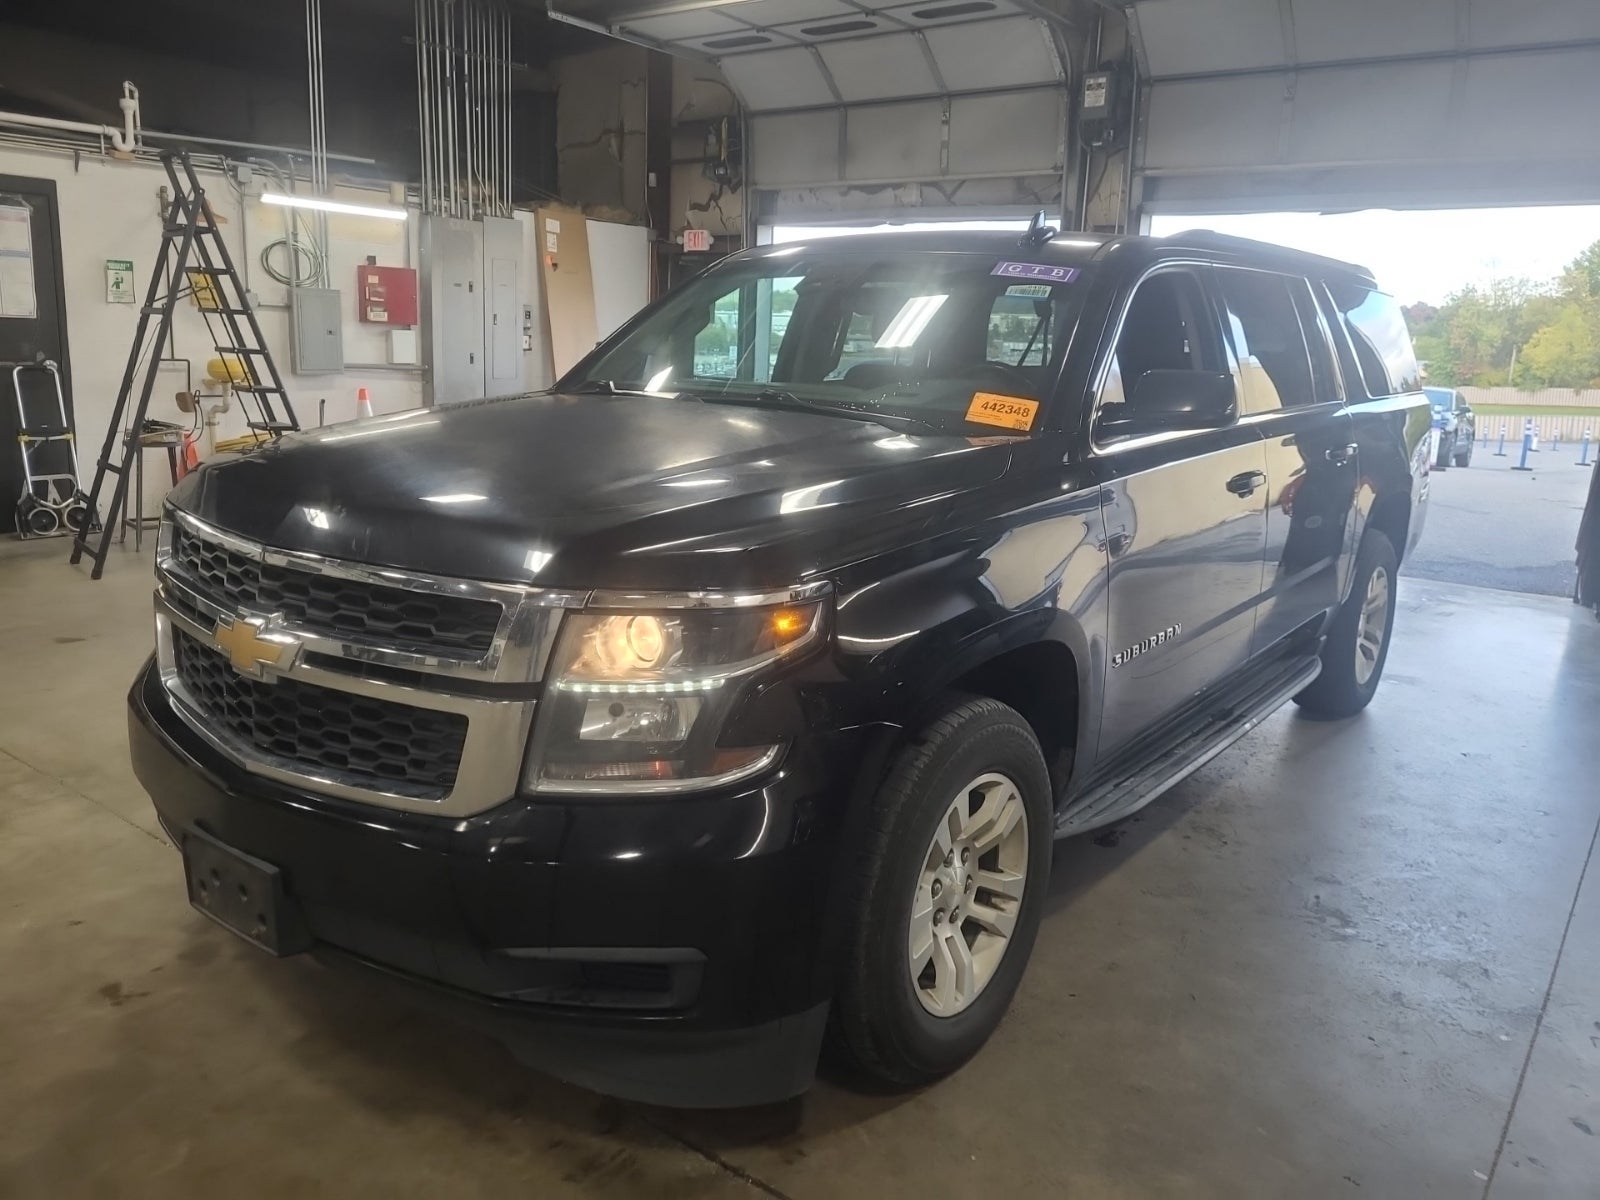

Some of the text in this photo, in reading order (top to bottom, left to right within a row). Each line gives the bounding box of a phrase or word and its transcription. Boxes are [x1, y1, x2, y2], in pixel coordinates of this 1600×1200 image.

[687, 231, 705, 249] EXIT
[980, 401, 1030, 418] 442348
[1112, 623, 1182, 669] SUBURBAN
